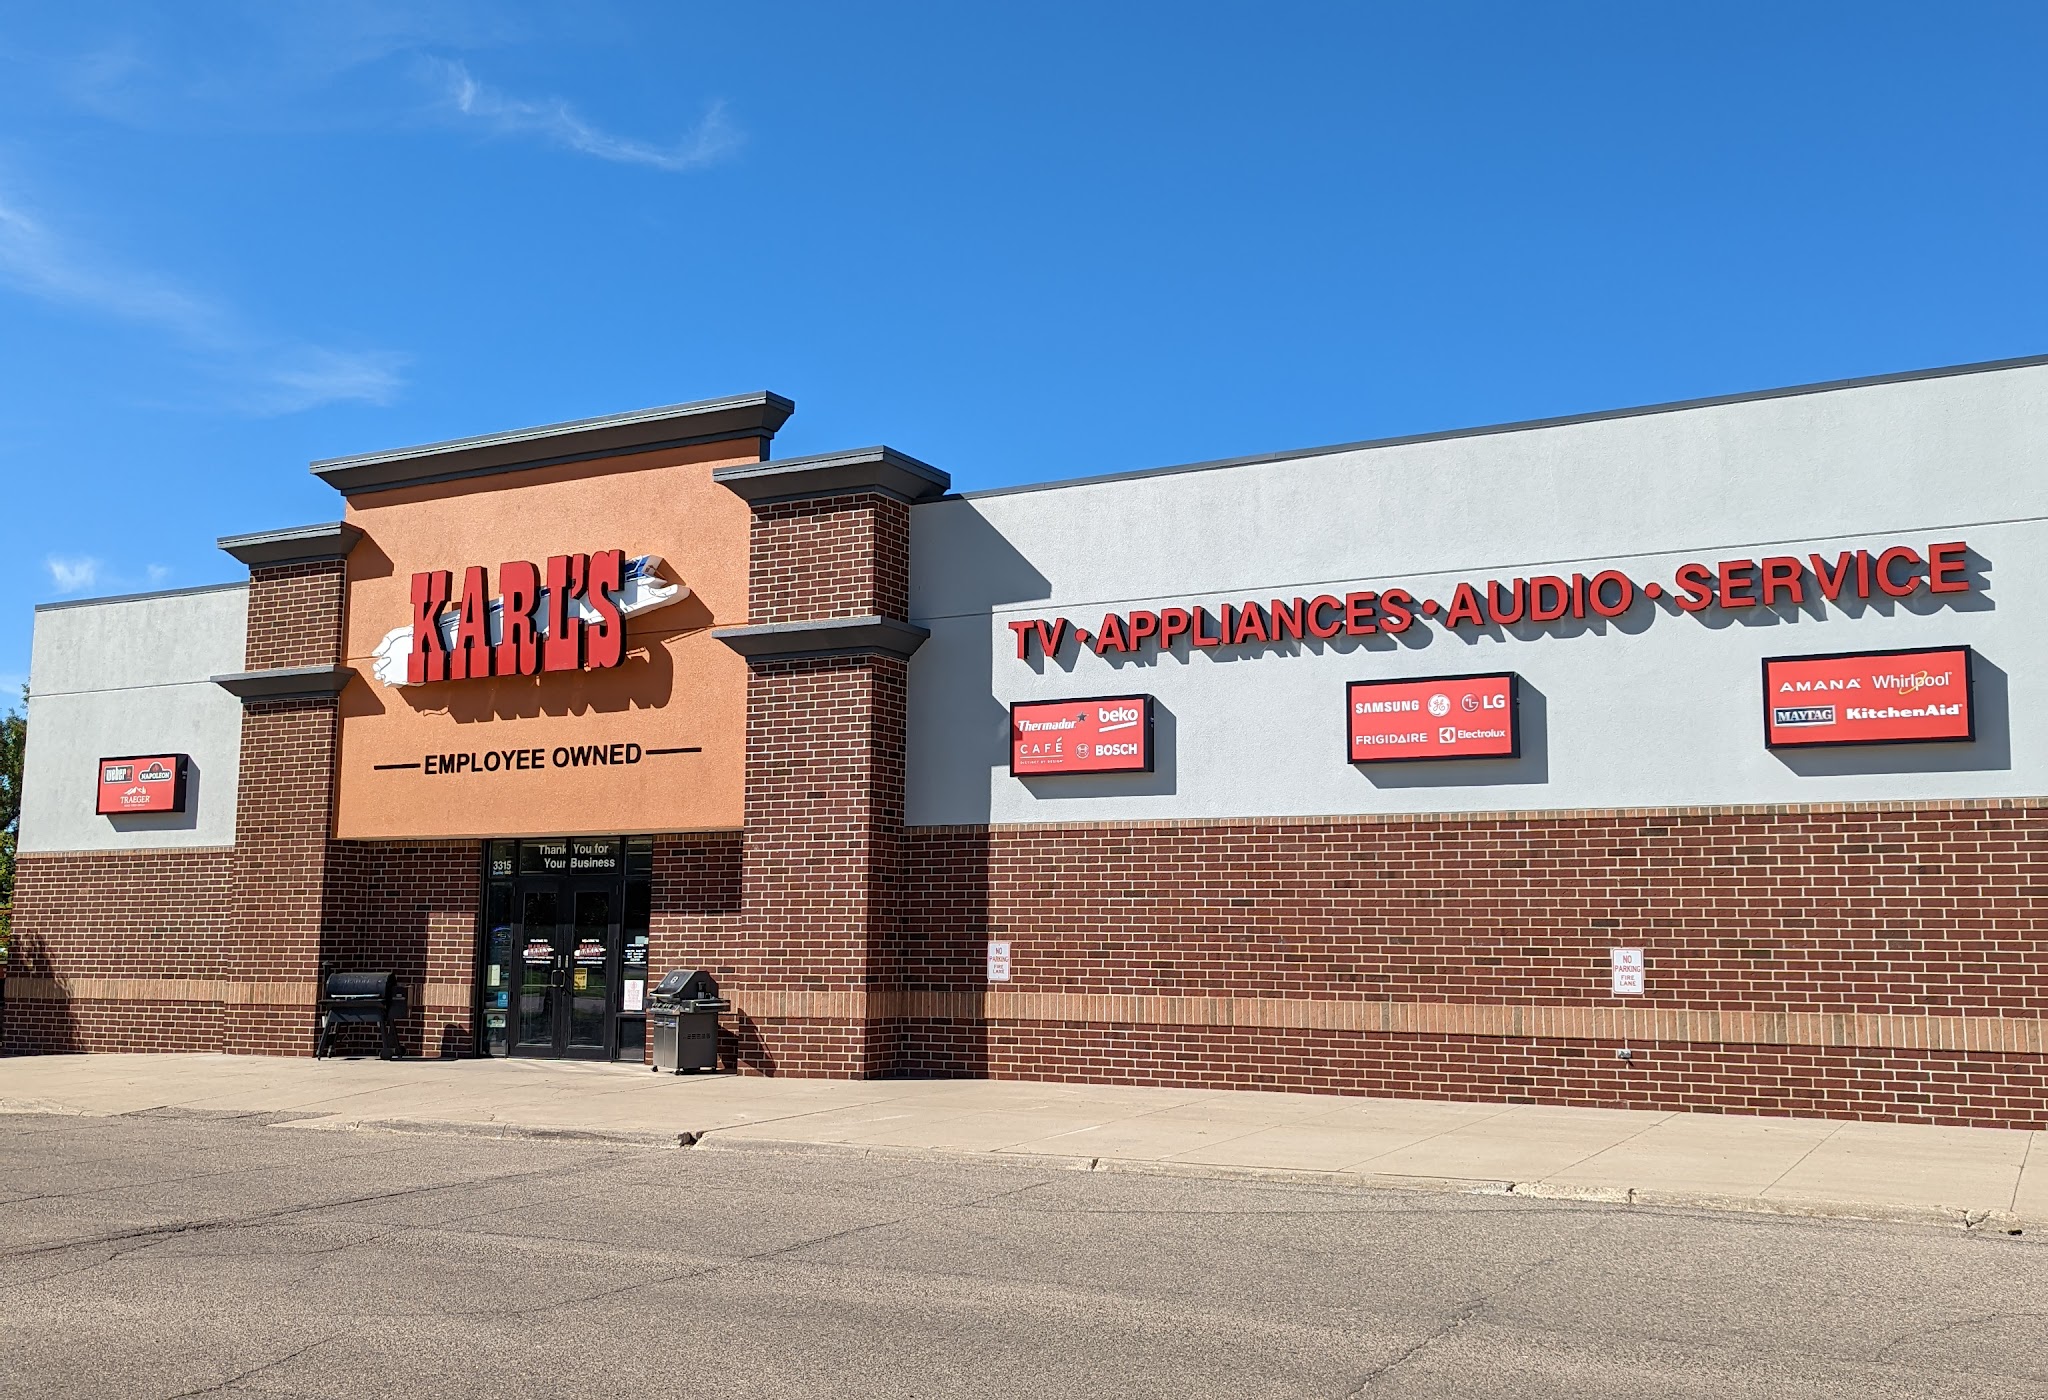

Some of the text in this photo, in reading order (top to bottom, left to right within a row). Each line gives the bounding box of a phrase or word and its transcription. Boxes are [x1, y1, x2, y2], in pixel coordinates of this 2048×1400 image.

[1009, 540, 1971, 660] TV APPLIANCES AUDIO SERVICE
[408, 549, 626, 683] KARL'S
[1779, 678, 1861, 693] AMANA
[1872, 671, 1950, 692] Whirlpool
[1355, 700, 1420, 714] SAMSUNG
[1483, 694, 1506, 709] LG
[1098, 707, 1139, 723] beko
[1777, 709, 1833, 723] MAYTAG
[1846, 703, 1960, 720] KitchenAid
[1018, 718, 1077, 732] Thermador
[1355, 732, 1429, 746] FRIGIDAIRE
[1457, 728, 1506, 739] Electrolux
[1020, 736, 1063, 755] CAFÉ
[1095, 743, 1138, 757] BOSCH
[424, 743, 642, 775] EMPLOYEE OWNED
[141, 772, 170, 780] NAPOLEON
[120, 795, 151, 804] TRAEGER
[539, 843, 609, 855] Thank You for
[493, 860, 512, 870] 3315
[570, 857, 616, 868] Business
[1623, 955, 1632, 963] NO
